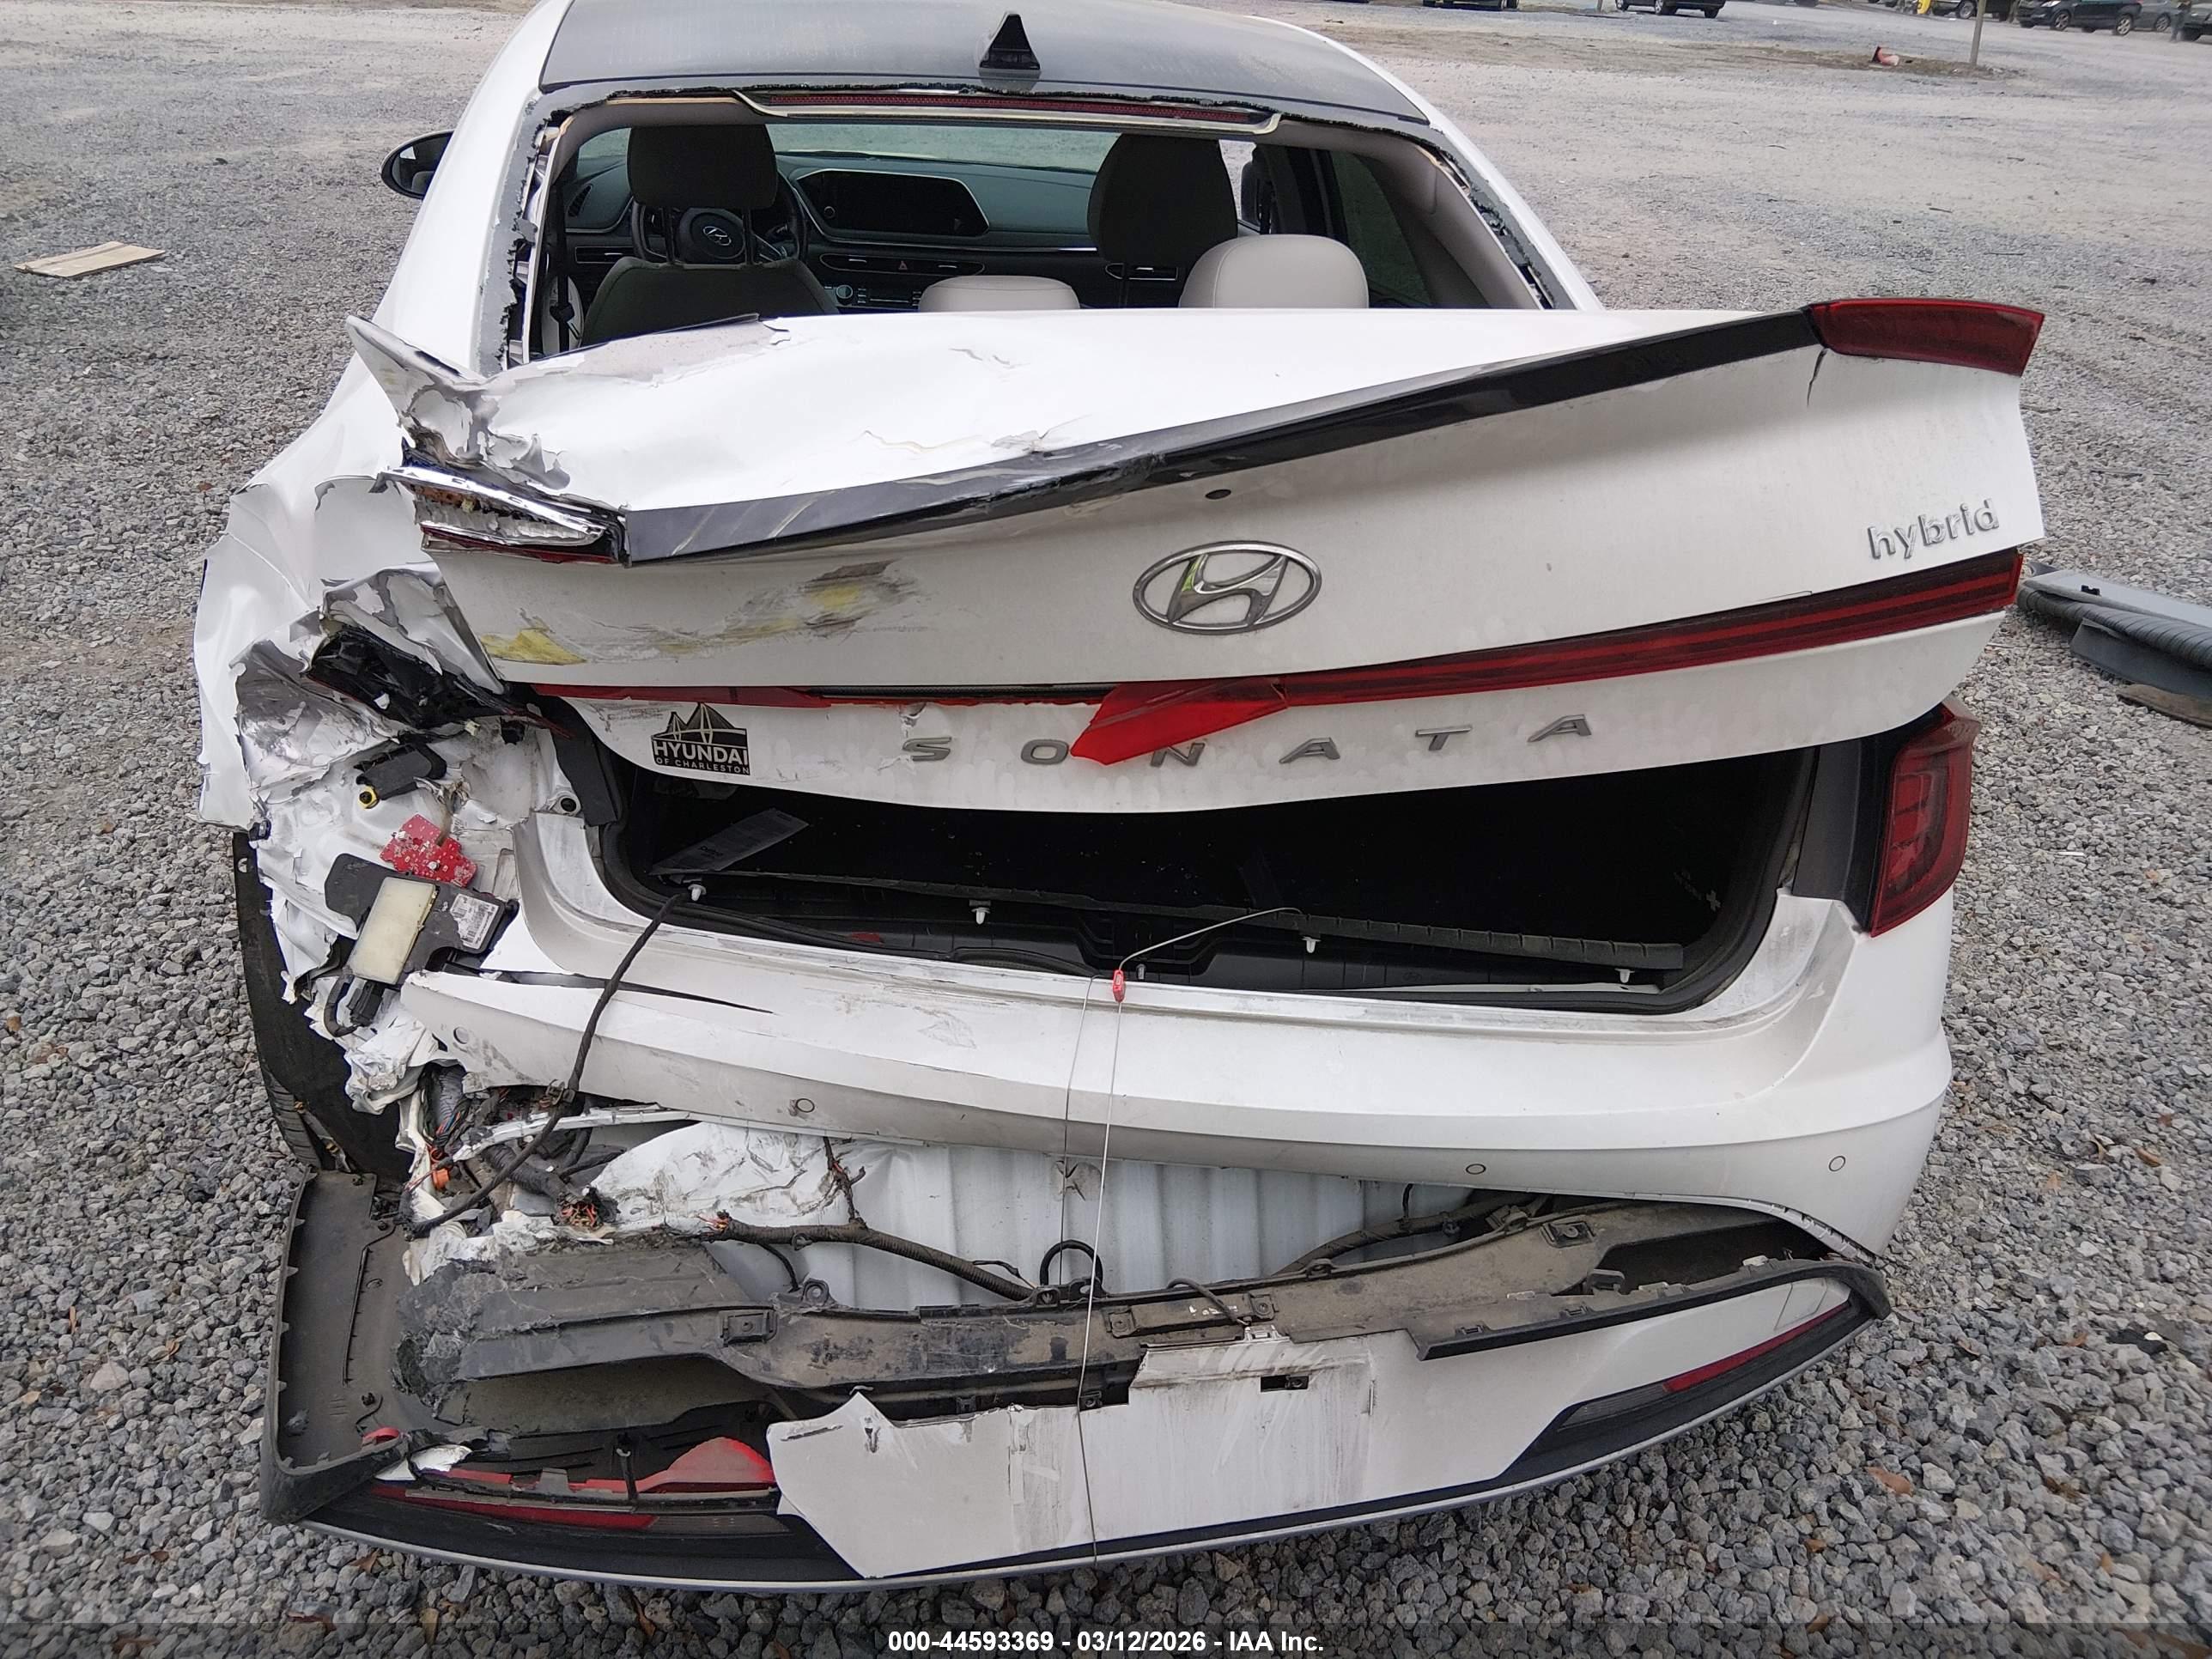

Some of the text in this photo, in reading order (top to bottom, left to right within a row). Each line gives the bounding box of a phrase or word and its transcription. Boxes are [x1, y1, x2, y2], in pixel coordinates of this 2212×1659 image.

[1867, 498, 2000, 559] hybrid
[653, 740, 749, 765] HYUNDAI
[902, 713, 1594, 768] SONATA
[674, 759, 750, 775] CHARLESTON
